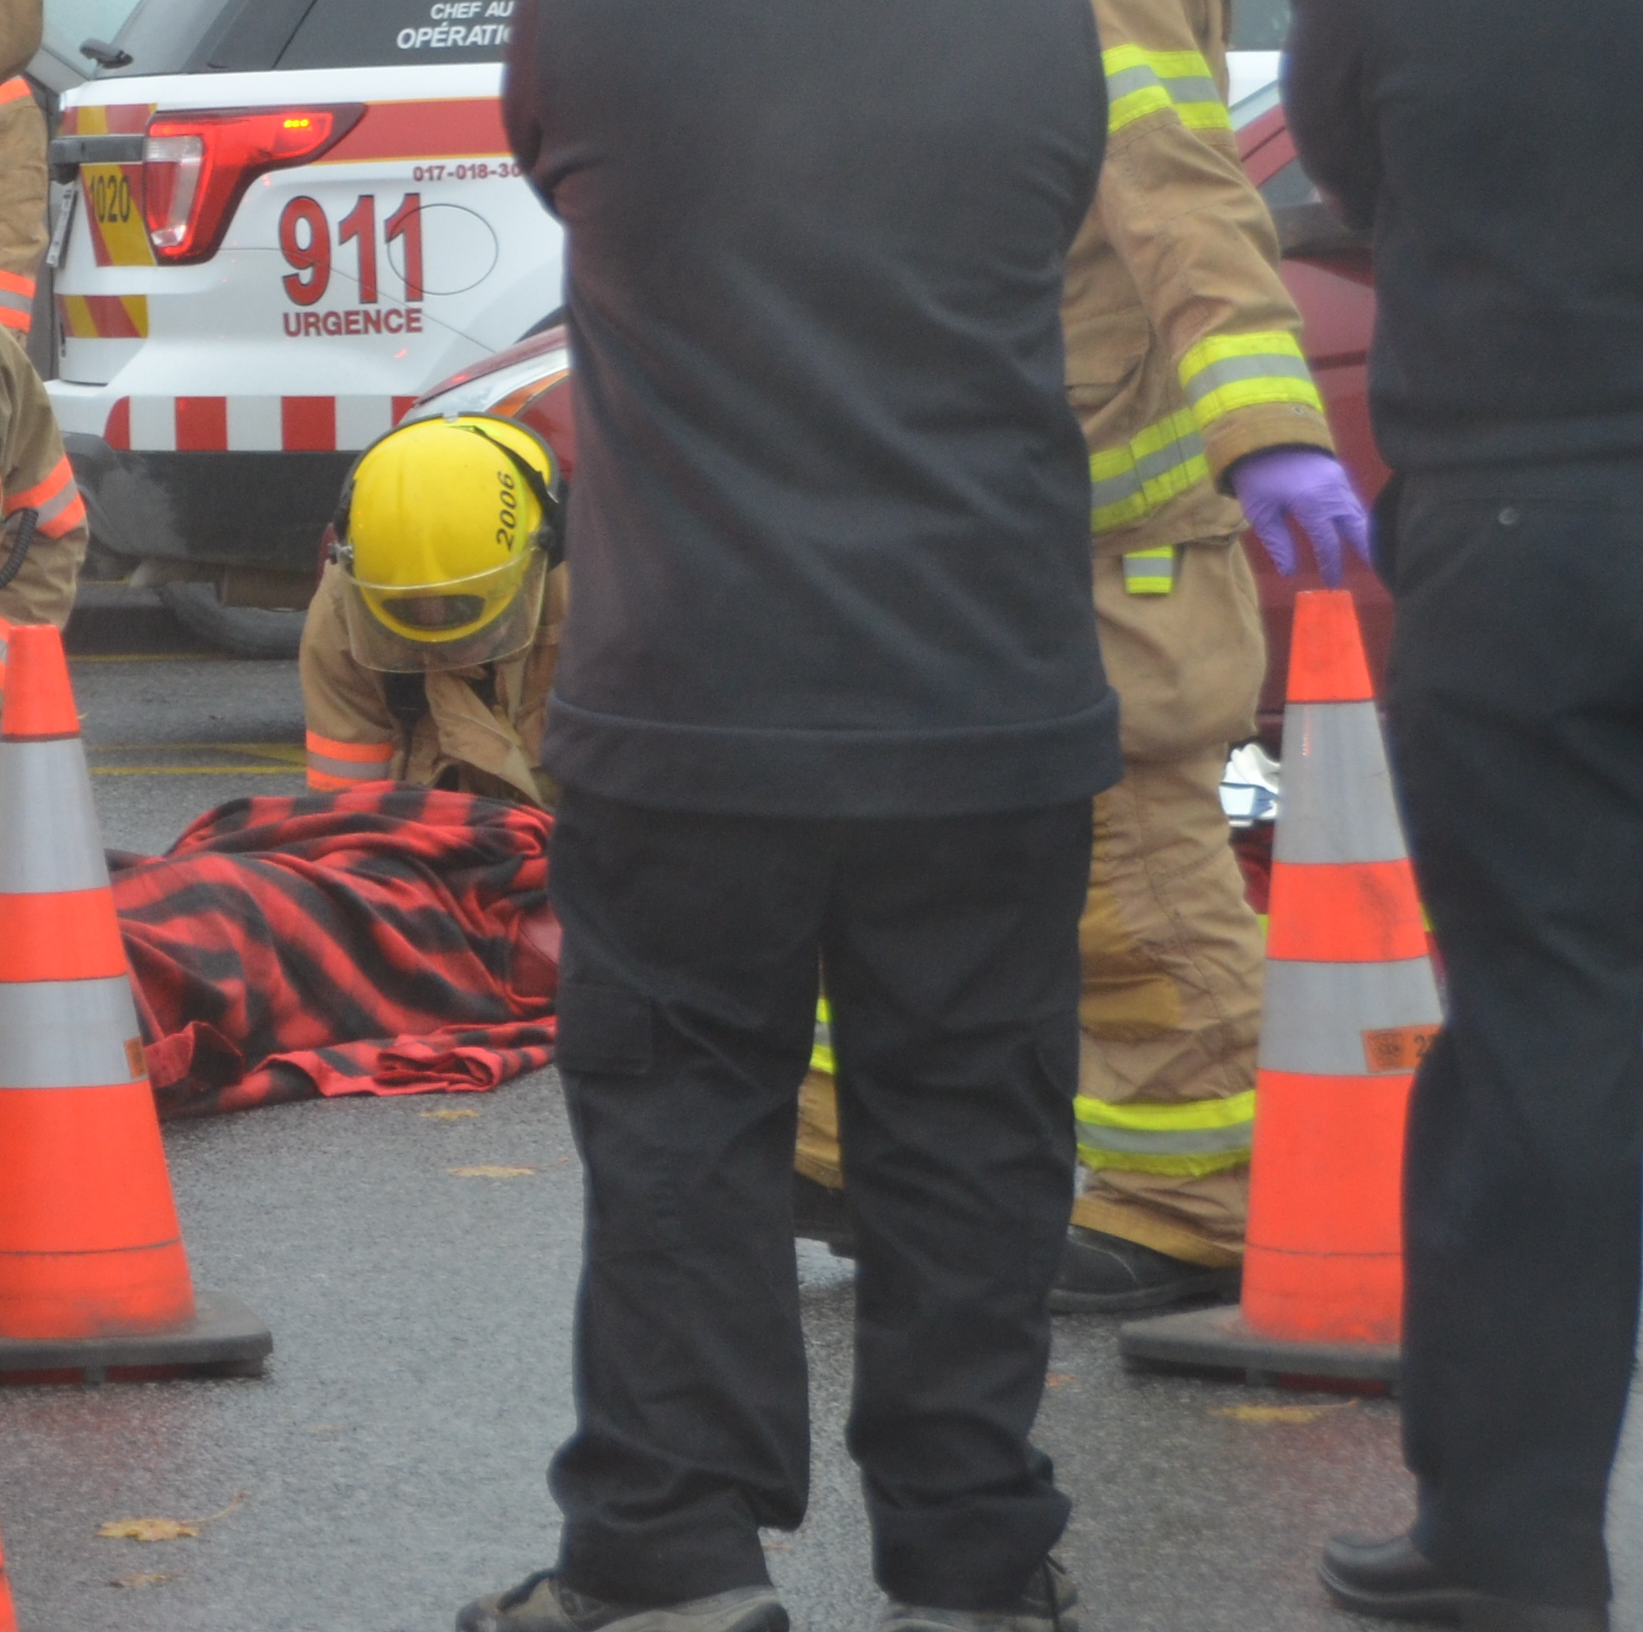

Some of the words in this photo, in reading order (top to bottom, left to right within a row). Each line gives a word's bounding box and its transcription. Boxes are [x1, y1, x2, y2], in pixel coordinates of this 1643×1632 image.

[430, 2, 482, 20] CHEF
[485, 0, 515, 18] AU
[89, 174, 131, 223] 1020
[278, 192, 424, 306] 911
[282, 308, 423, 338] URGENCE
[495, 471, 517, 552] 2006
